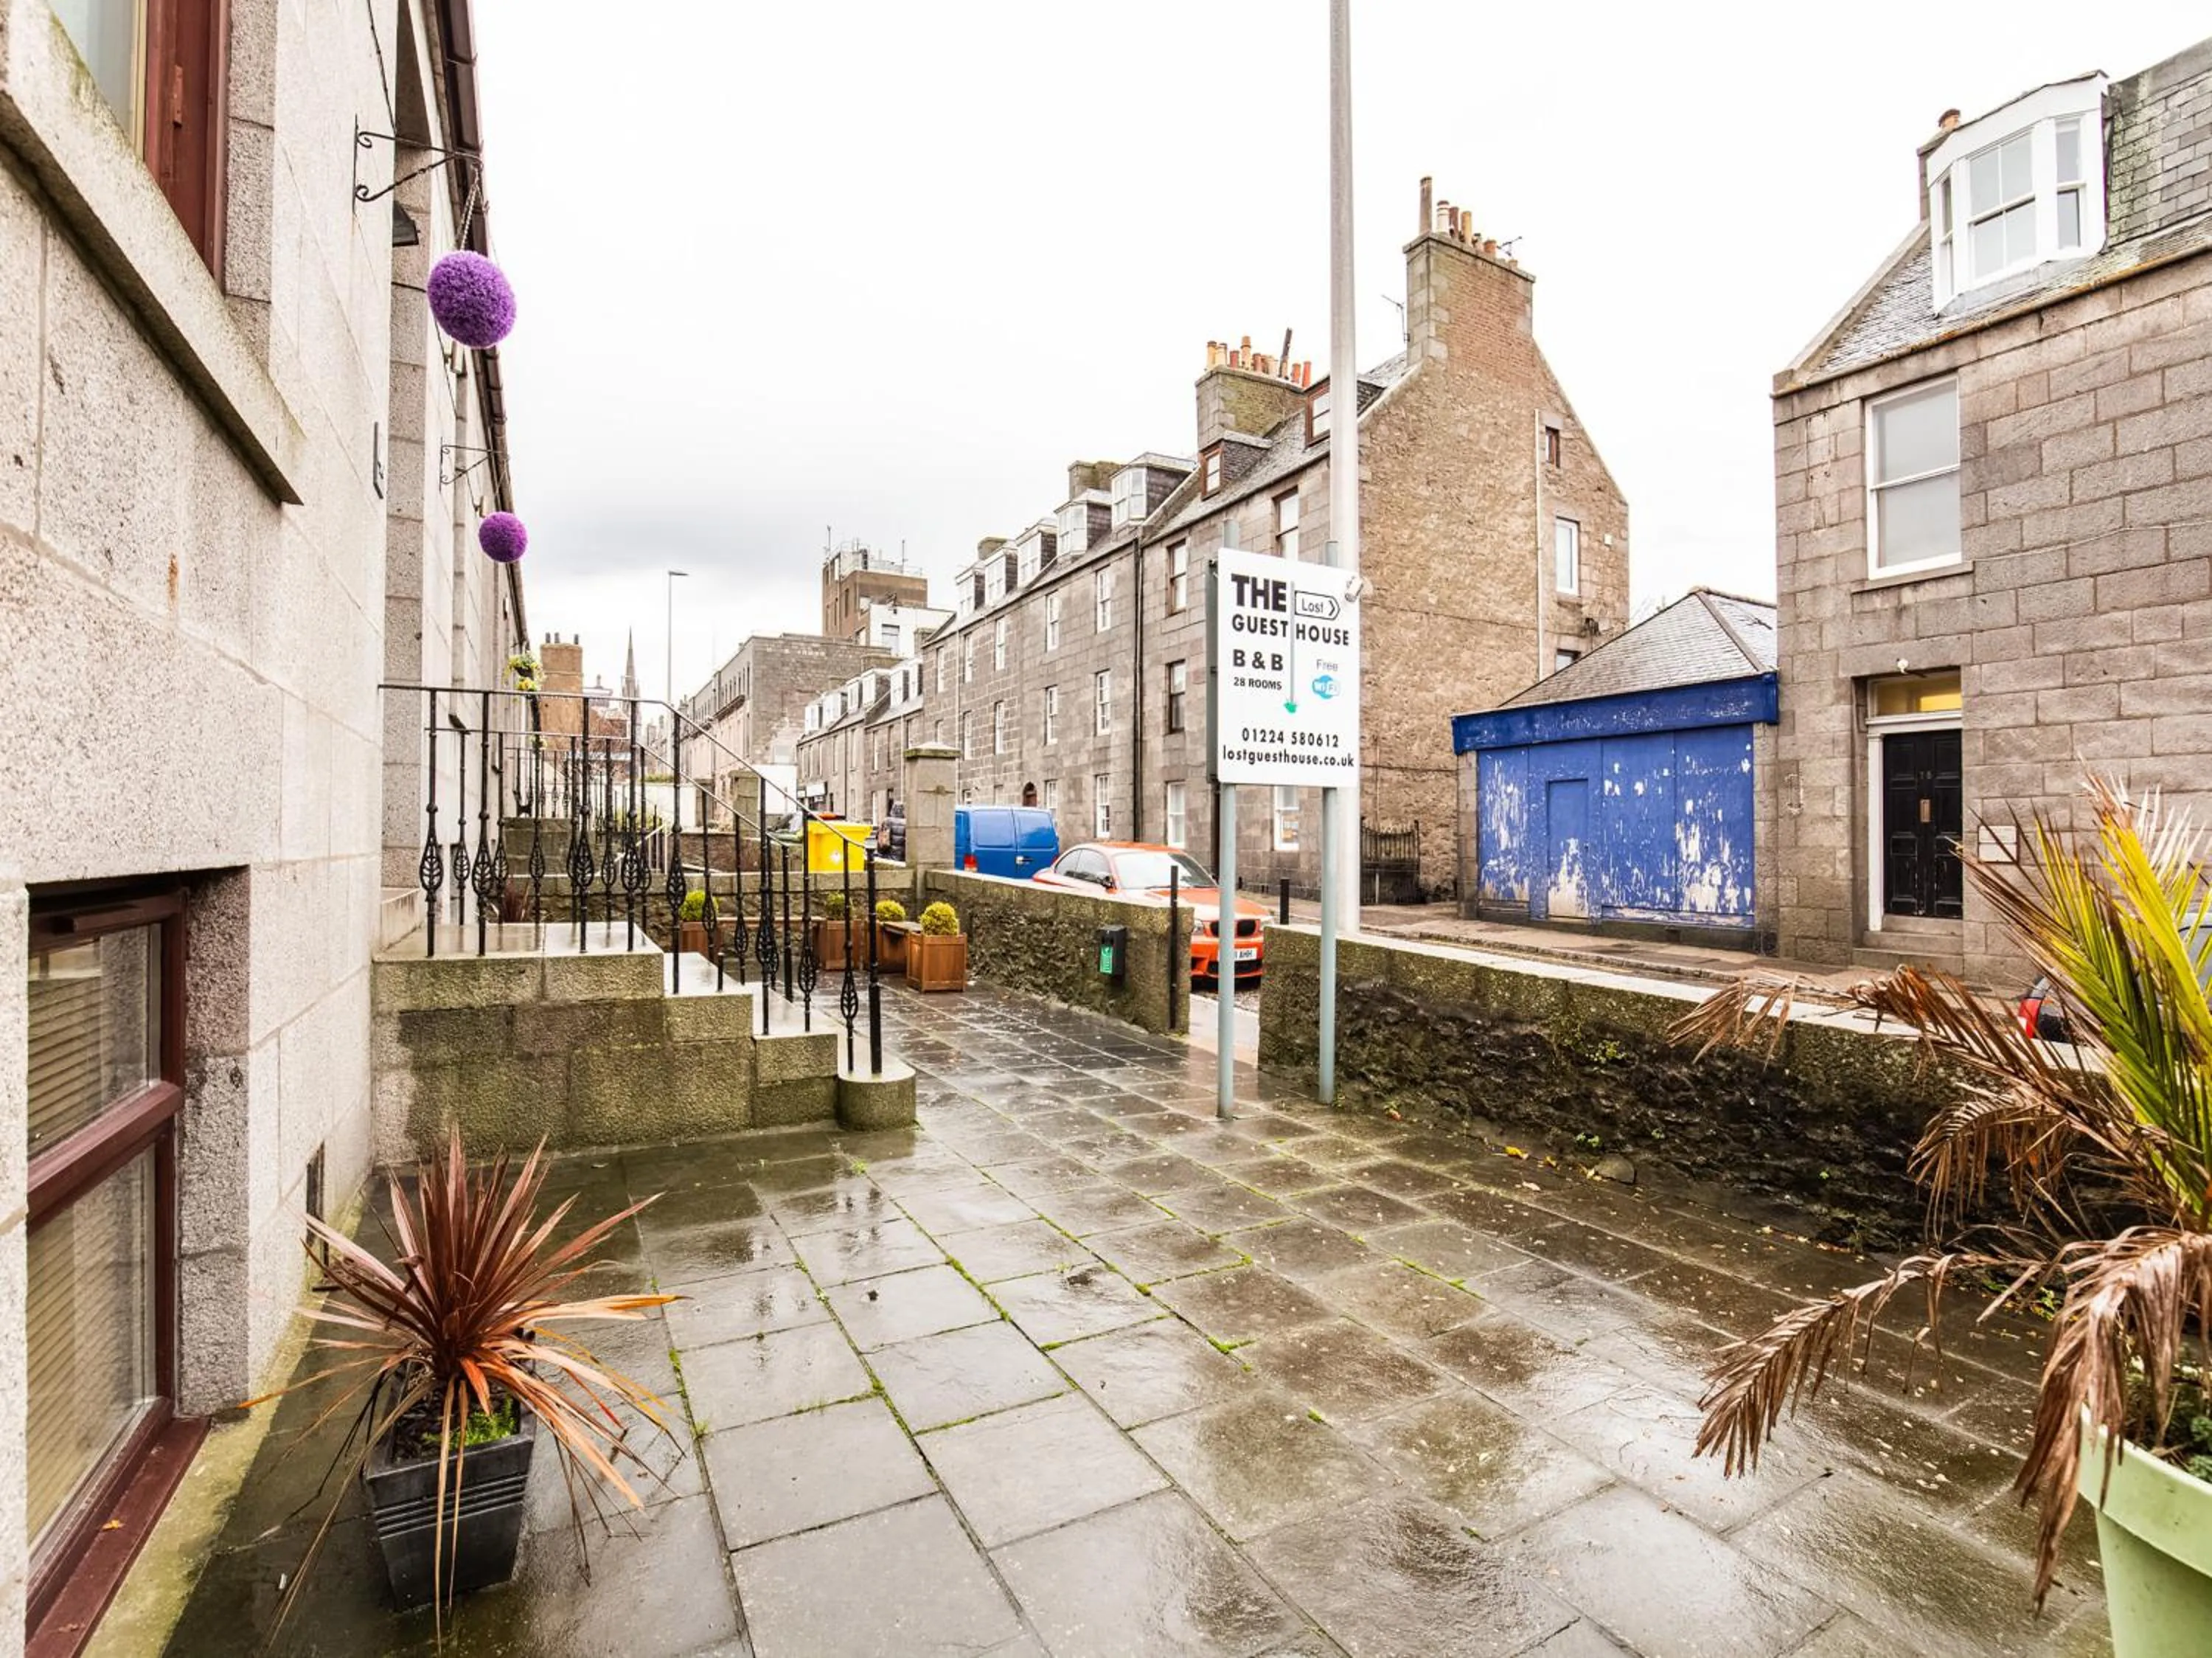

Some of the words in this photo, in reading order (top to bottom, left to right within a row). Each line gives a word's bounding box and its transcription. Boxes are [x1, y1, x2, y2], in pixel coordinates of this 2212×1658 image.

[1231, 573, 1287, 612] THE
[1301, 598, 1324, 613] Lost
[1232, 614, 1288, 637] GUEST
[1295, 623, 1349, 646] HOUSE
[1233, 649, 1245, 667] B
[1252, 651, 1265, 670] &
[1271, 653, 1284, 670] B
[1316, 659, 1338, 671] Free
[1234, 677, 1245, 687] 28
[1248, 679, 1282, 690] ROOMS
[1242, 727, 1284, 743] 01224
[1291, 732, 1339, 748] 580612
[1223, 745, 1354, 767] lostguesthouse.co.uk
